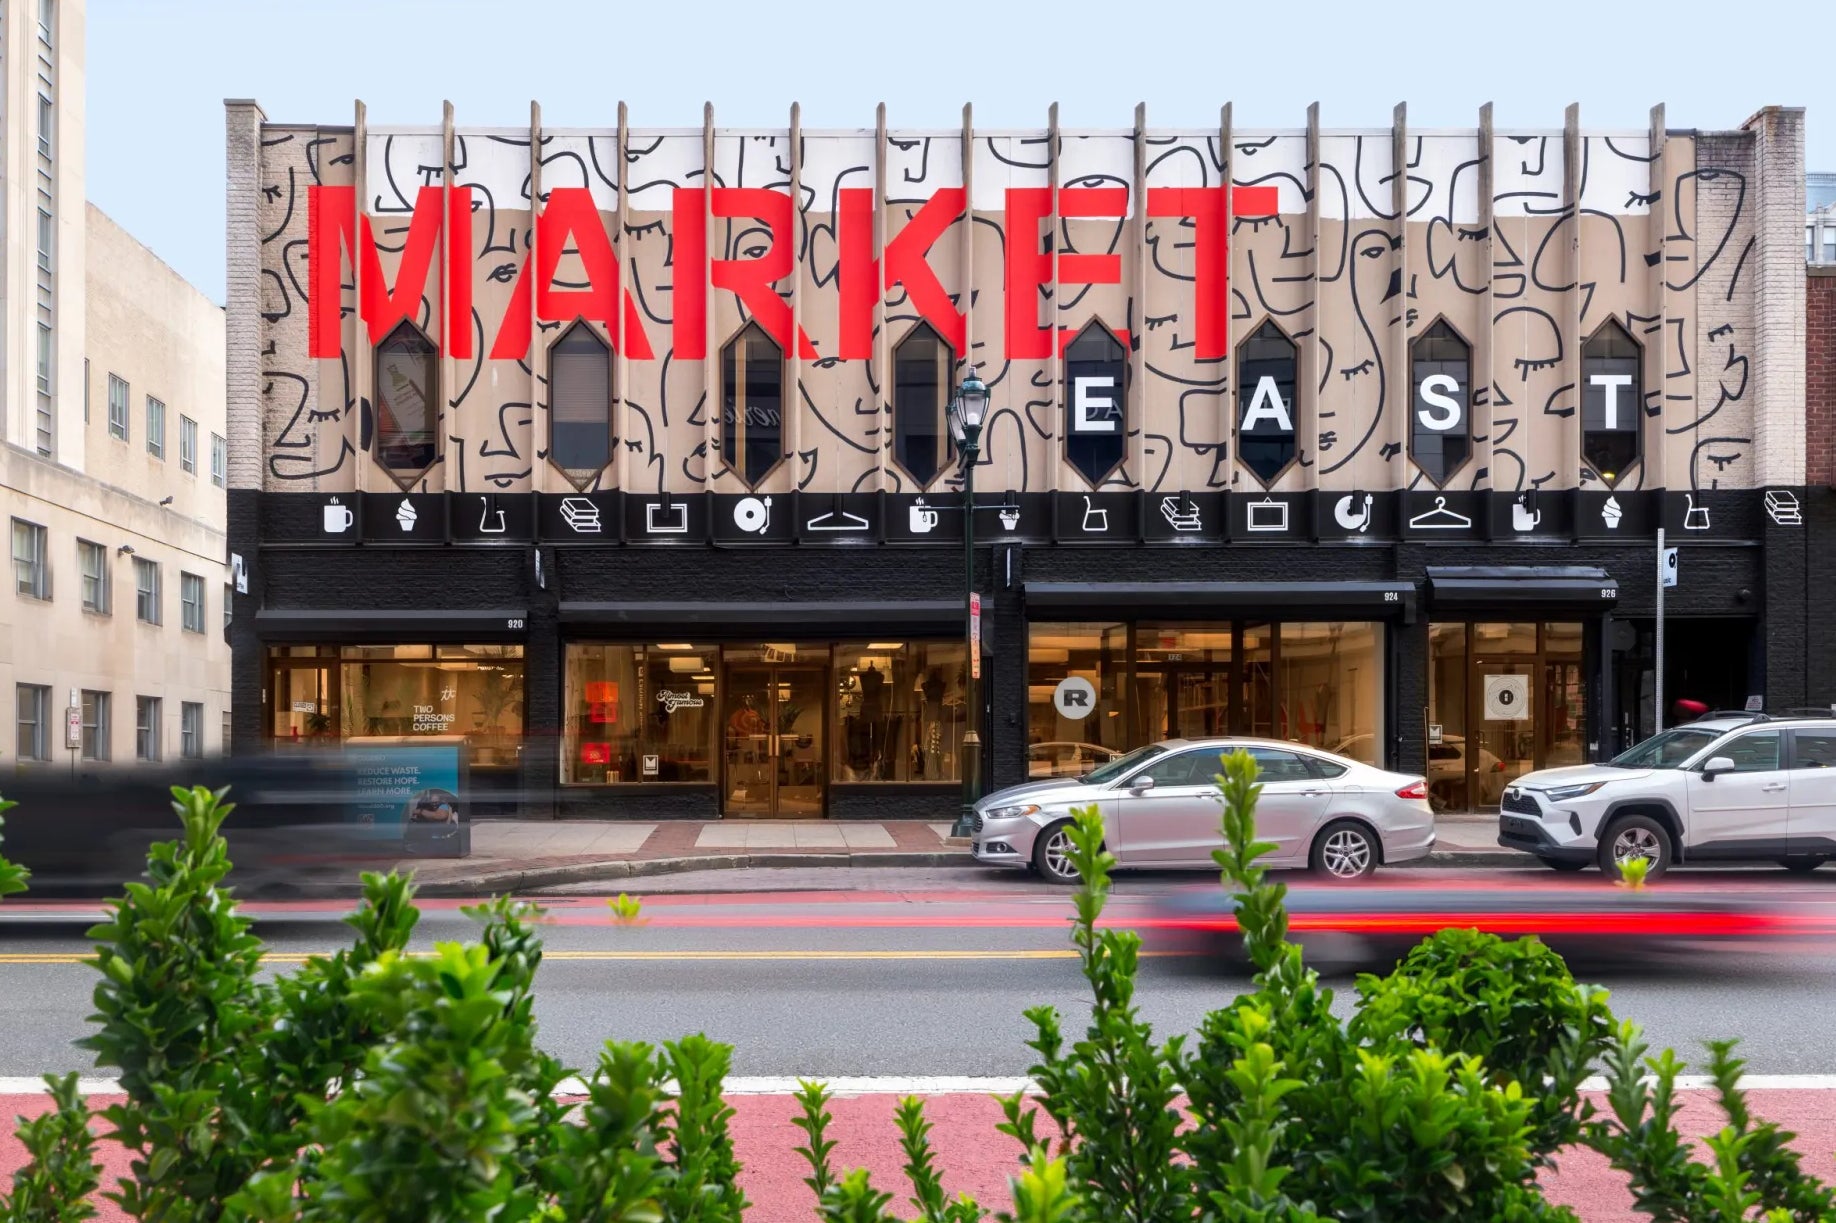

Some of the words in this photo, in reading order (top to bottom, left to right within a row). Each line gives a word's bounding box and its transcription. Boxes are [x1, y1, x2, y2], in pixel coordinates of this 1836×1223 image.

[308, 184, 1278, 360] MARKET
[1075, 374, 1632, 431] EAST
[1384, 592, 1398, 601] 924
[1601, 589, 1616, 598] 926
[508, 619, 523, 629] 920
[1063, 689, 1088, 706] R
[413, 705, 433, 714] TWO
[665, 698, 703, 713] Famous
[413, 714, 456, 722] PERSONS
[412, 722, 449, 731] COFFEE
[391, 767, 421, 775] WASTE.
[394, 777, 421, 785] HOPE.
